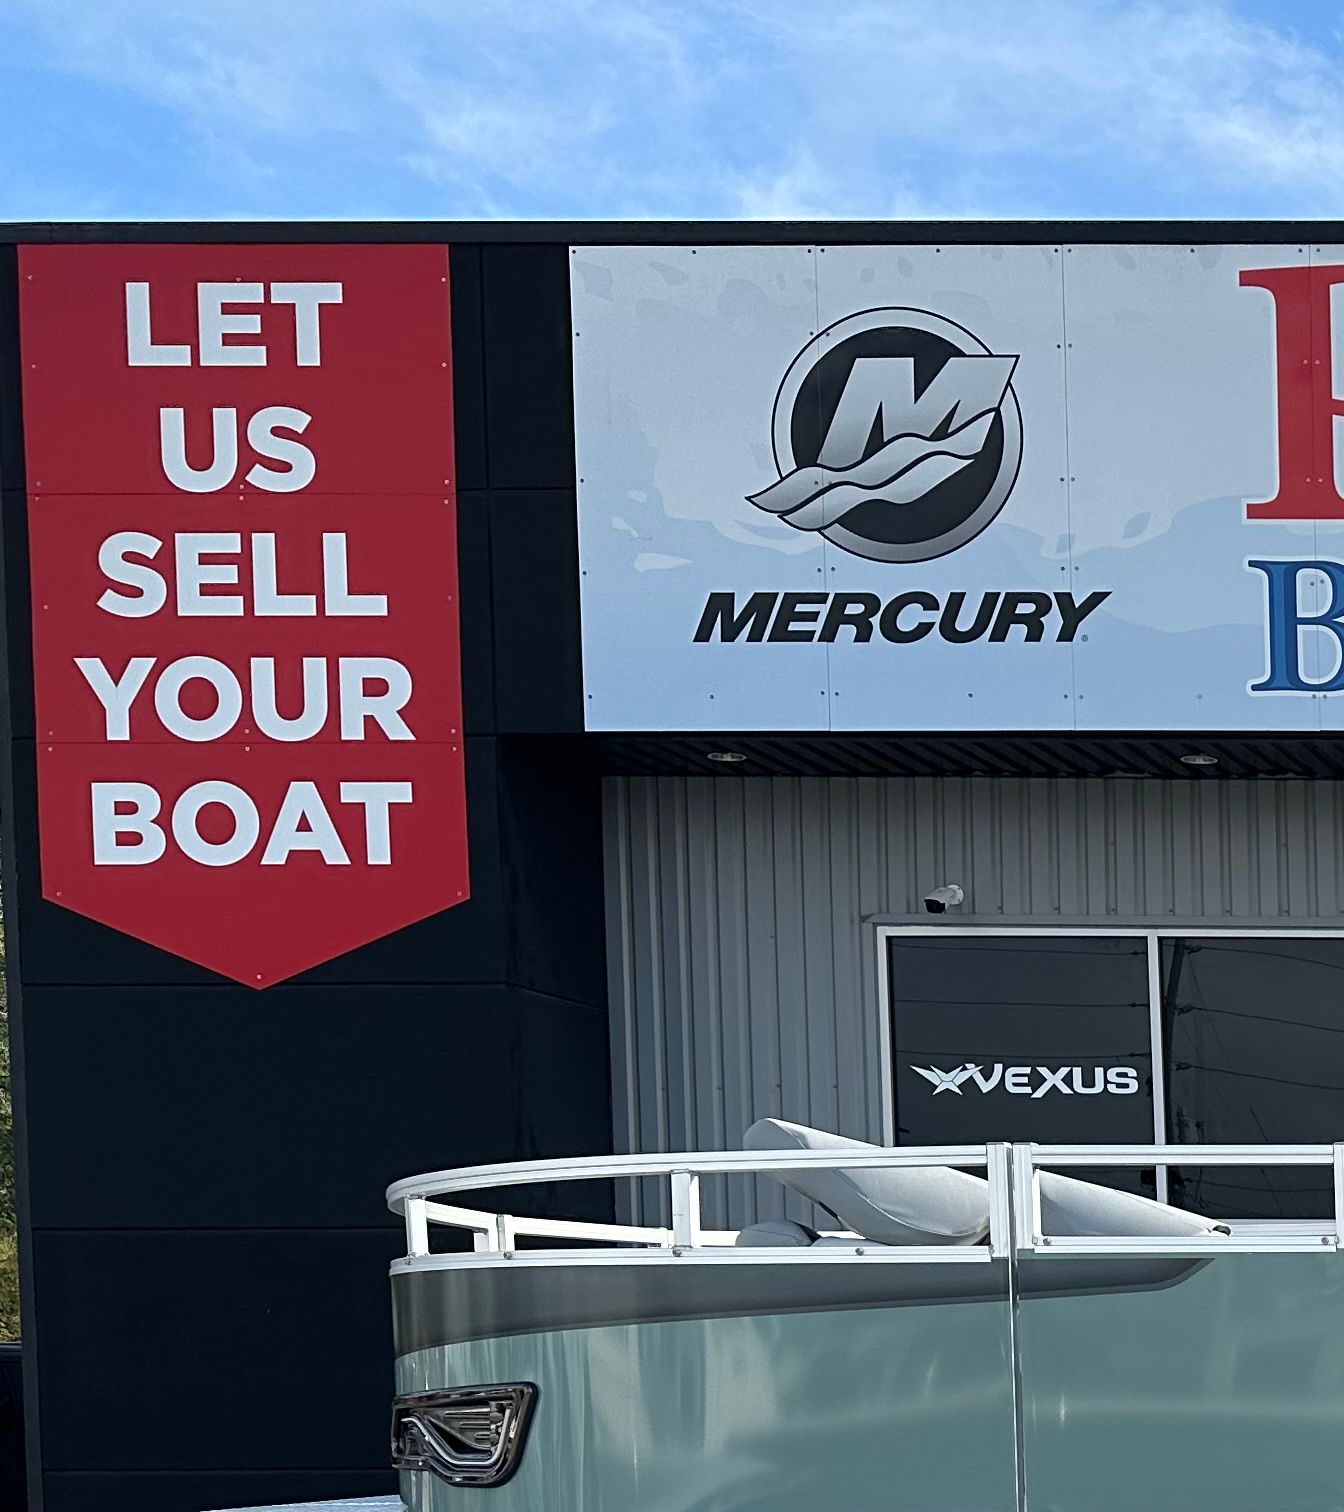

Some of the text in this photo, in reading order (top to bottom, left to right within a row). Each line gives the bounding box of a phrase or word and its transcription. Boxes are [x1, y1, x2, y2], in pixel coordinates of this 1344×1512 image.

[125, 281, 344, 369] LET
[158, 405, 315, 493] US
[96, 531, 388, 618] SELL
[692, 591, 1113, 644] MERCURY
[73, 656, 416, 742] YOUR
[91, 780, 413, 867] BOAT
[964, 1063, 1139, 1099] VEXUS
